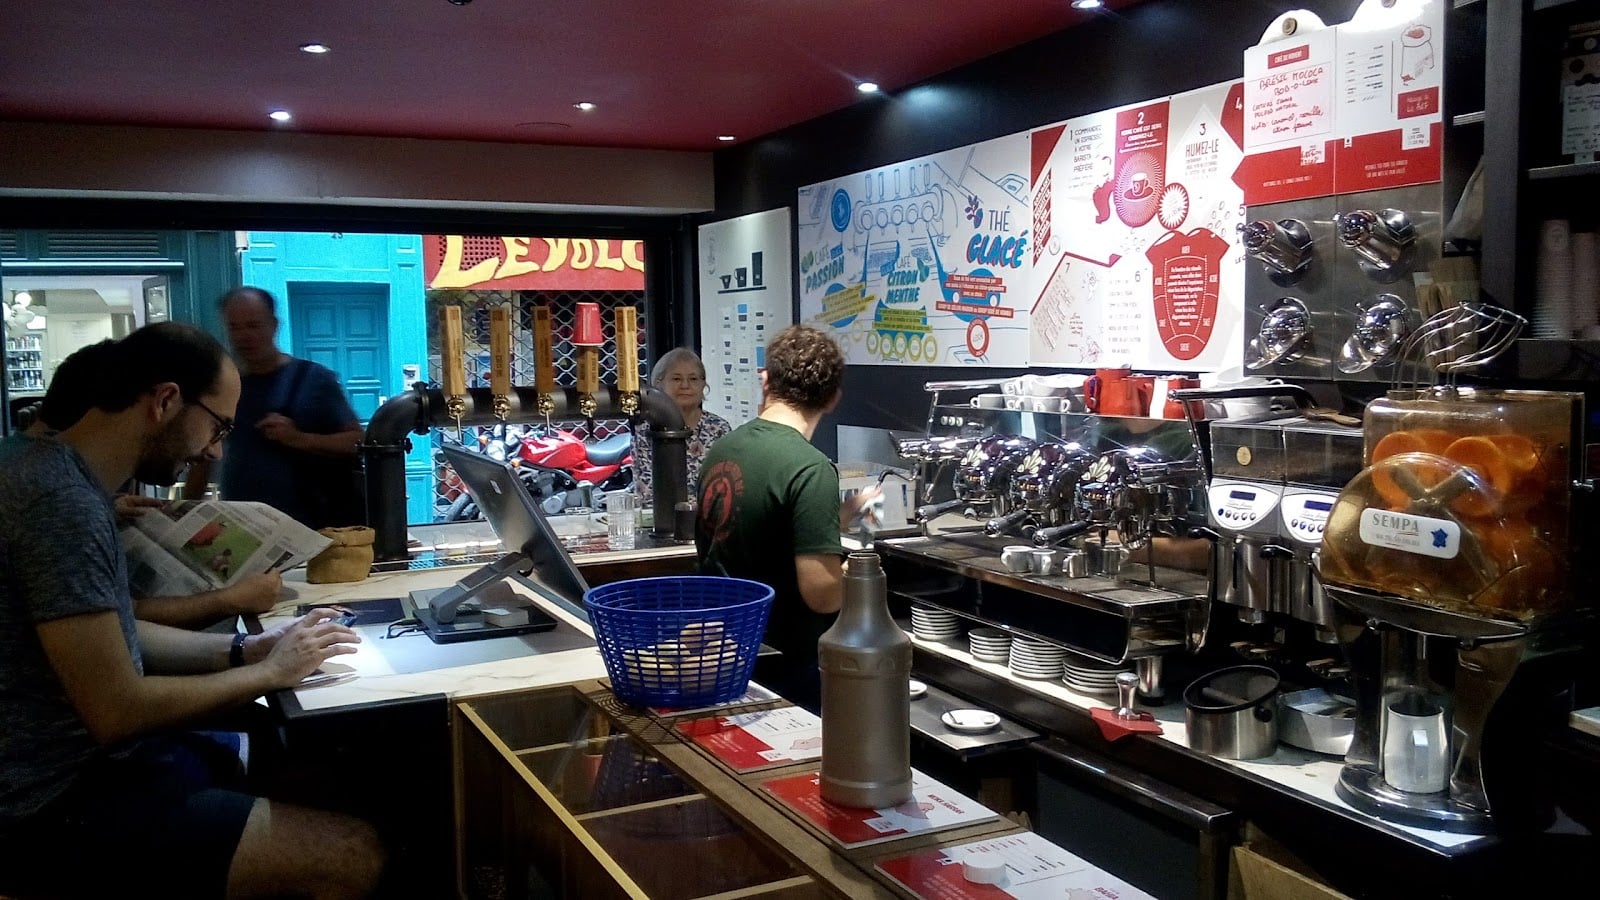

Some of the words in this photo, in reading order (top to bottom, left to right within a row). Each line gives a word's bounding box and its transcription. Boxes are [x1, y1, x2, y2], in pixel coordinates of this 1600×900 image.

[1235, 97, 1243, 111] 4
[1137, 111, 1145, 124] 2
[1199, 123, 1206, 136] 3
[1185, 138, 1220, 158] HUMEZ-LE
[988, 205, 1011, 232] THÉ
[1238, 203, 1246, 217] 5
[966, 229, 1029, 269] GLACÉ
[805, 255, 845, 294] PASSION
[1065, 262, 1071, 274] 7
[1134, 270, 1141, 283] 6
[887, 269, 919, 287] CITRON
[885, 286, 921, 304] MENTHE
[1371, 513, 1420, 533] SEMPA
